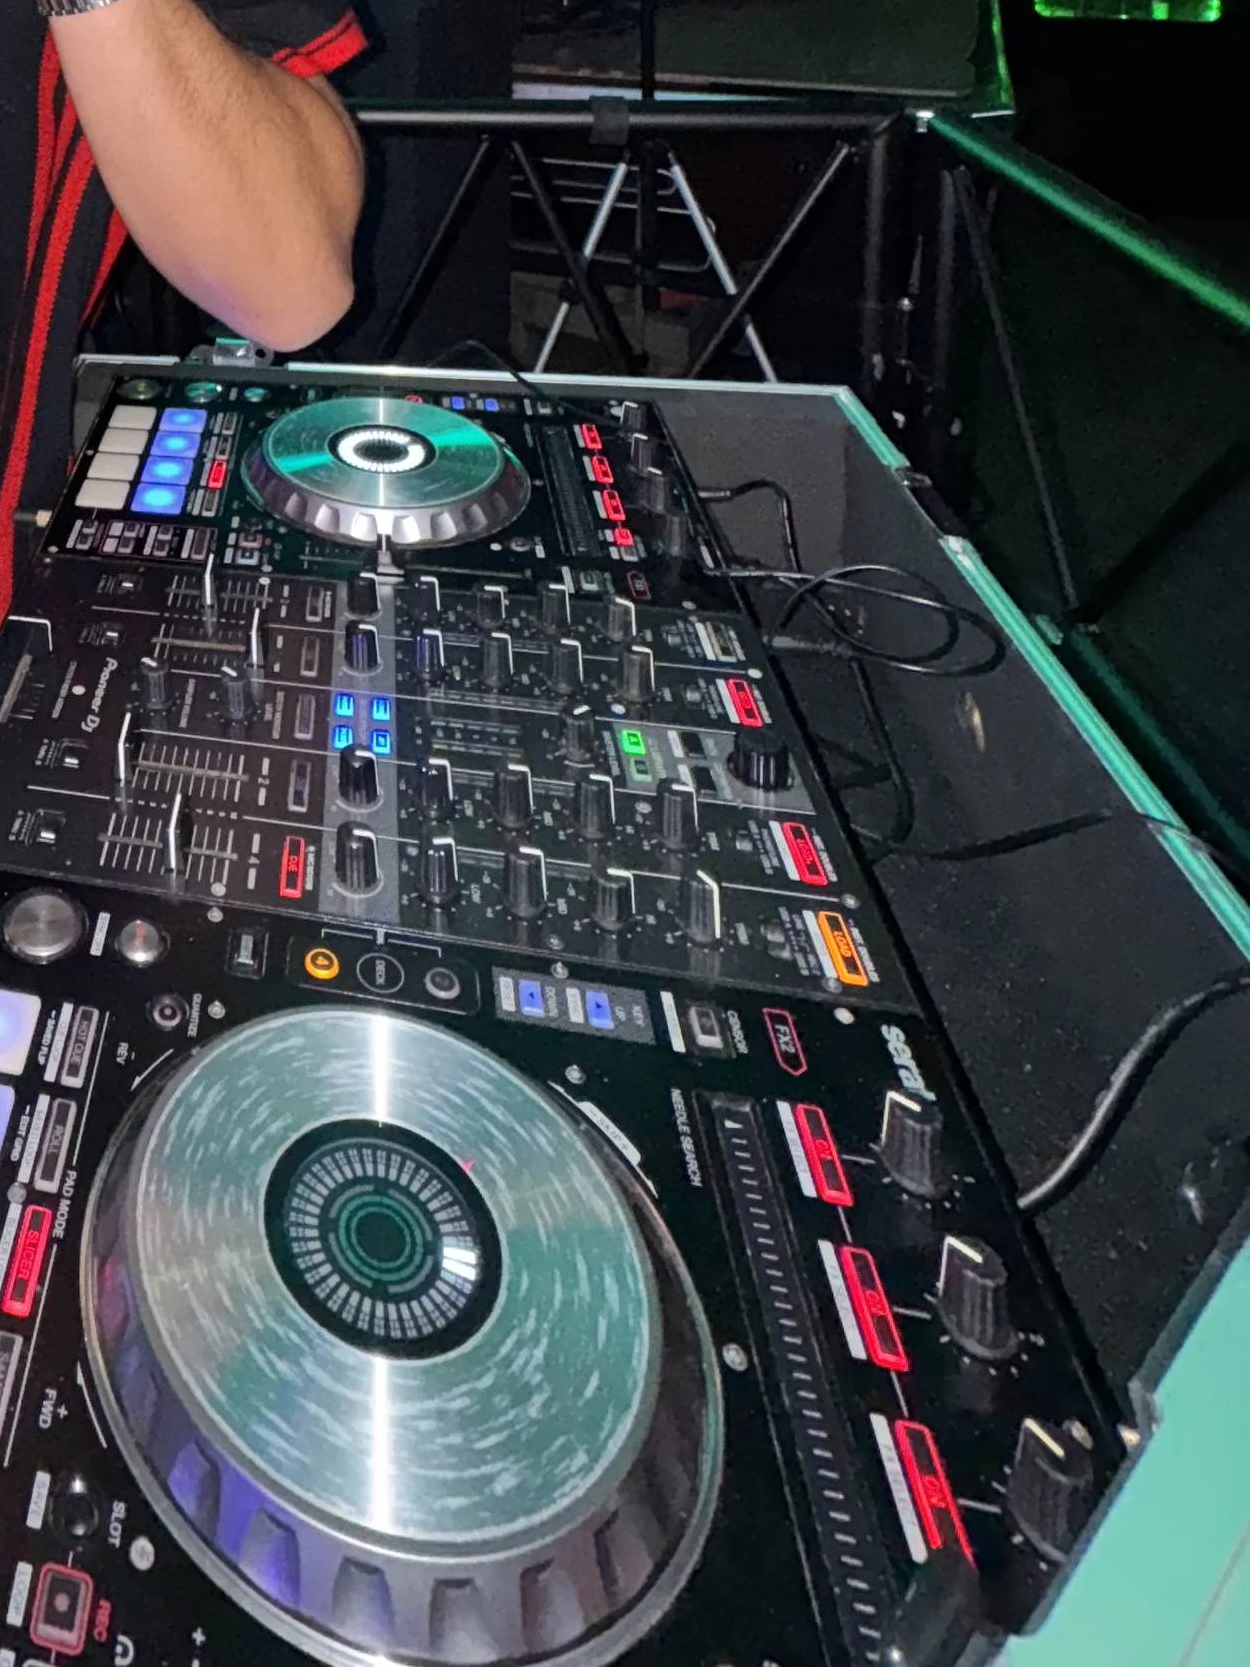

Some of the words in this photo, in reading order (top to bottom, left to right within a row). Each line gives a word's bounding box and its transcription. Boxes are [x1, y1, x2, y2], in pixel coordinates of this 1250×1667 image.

[89, 656, 118, 714] Pioneer
[833, 928, 851, 959] LOAD
[373, 959, 388, 986] DECK
[187, 993, 202, 1038] QUANTIZE
[116, 1042, 129, 1065] REV
[774, 1021, 796, 1056] FX2
[61, 1170, 77, 1197] PAD
[52, 1198, 71, 1239] MODE
[17, 1229, 40, 1281] SLICER
[38, 1387, 57, 1429] FWD
[107, 1500, 127, 1547] SLOT
[93, 1599, 111, 1641] REC
